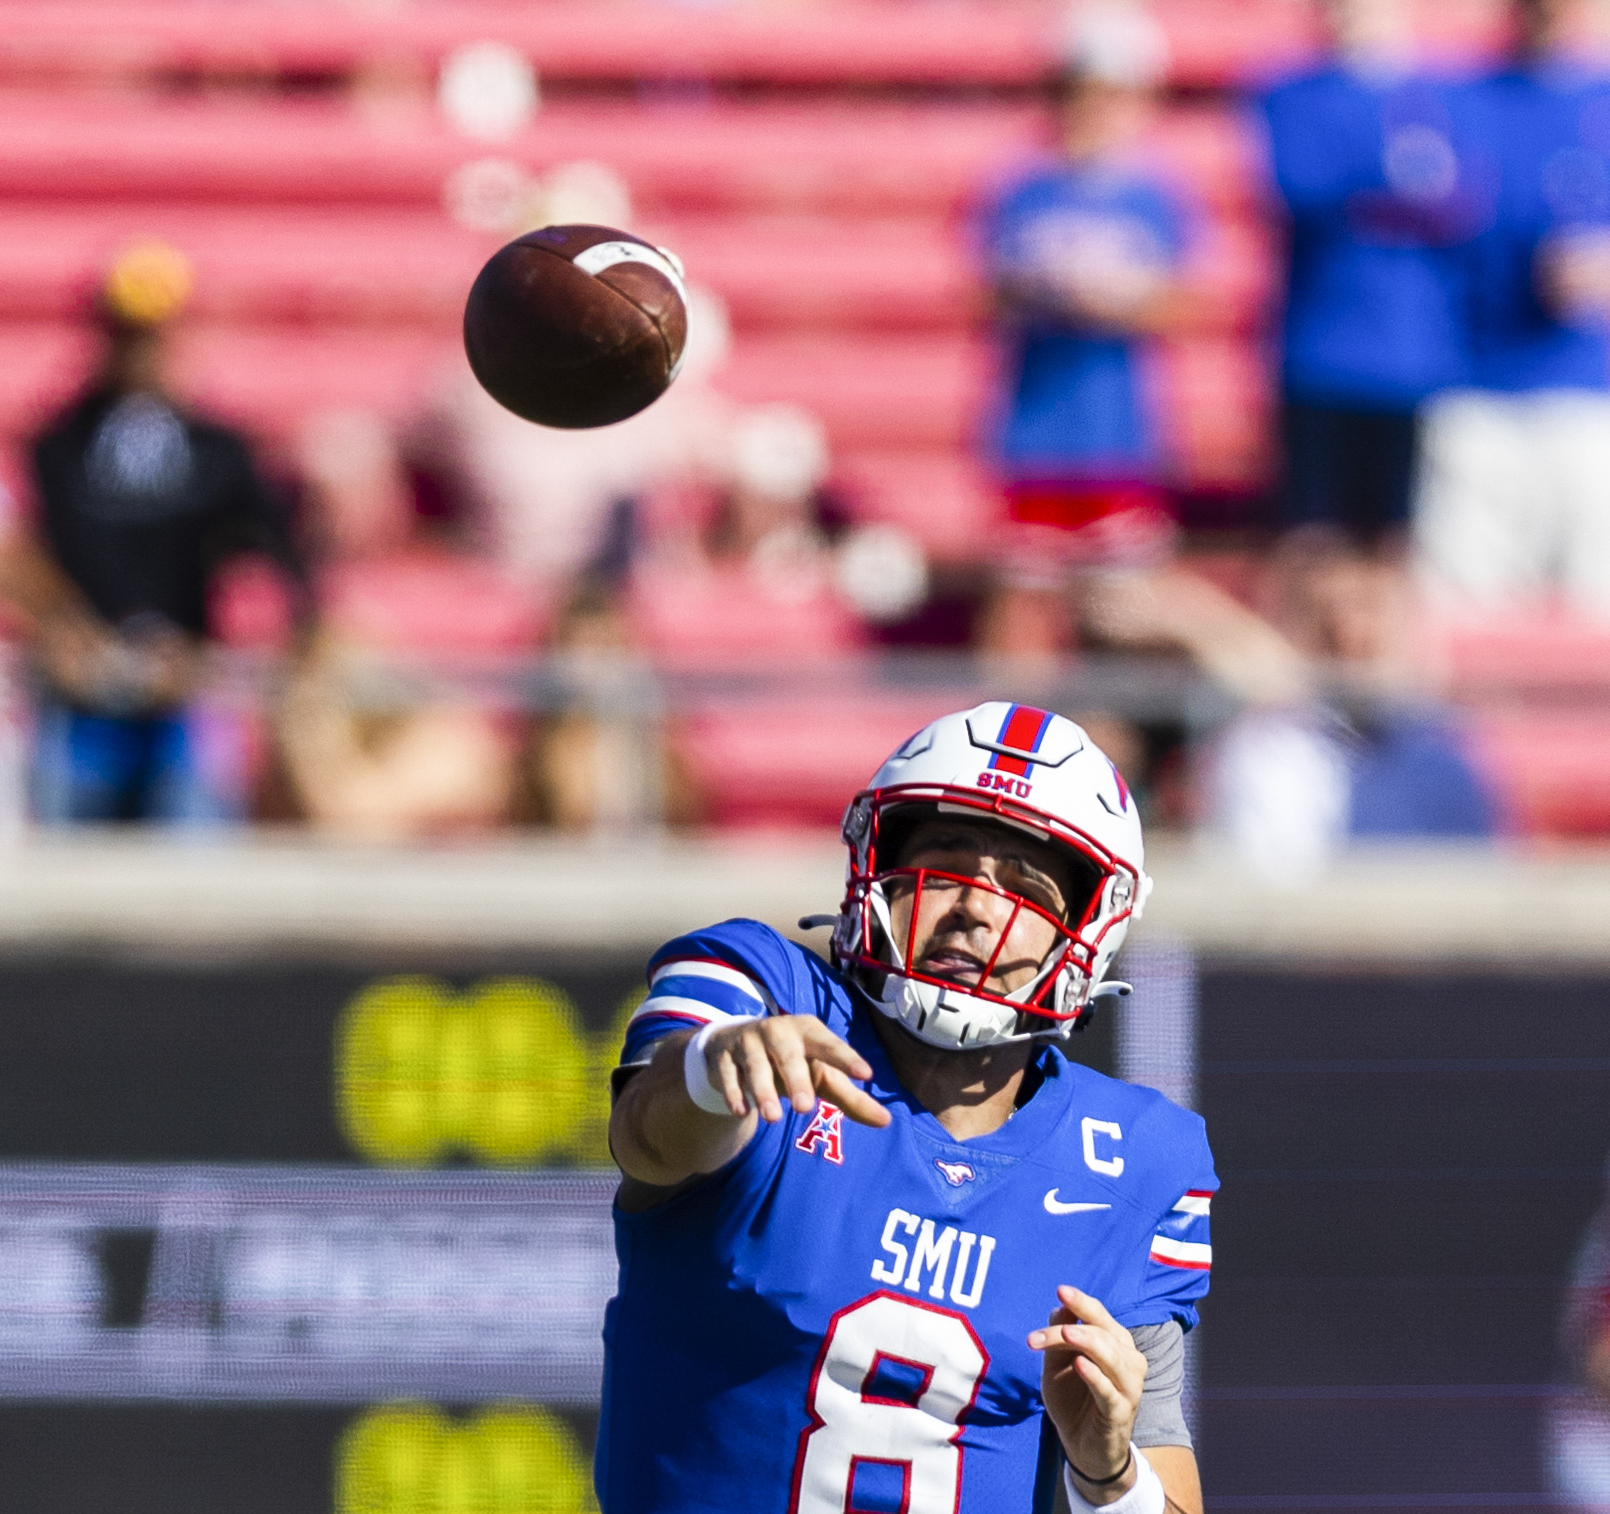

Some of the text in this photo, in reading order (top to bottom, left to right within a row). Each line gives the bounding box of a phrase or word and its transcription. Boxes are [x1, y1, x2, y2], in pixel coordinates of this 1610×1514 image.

[977, 772, 1032, 798] SMU
[795, 1100, 844, 1166] A
[1081, 1116, 1124, 1177] C
[871, 1208, 996, 1308] SMU
